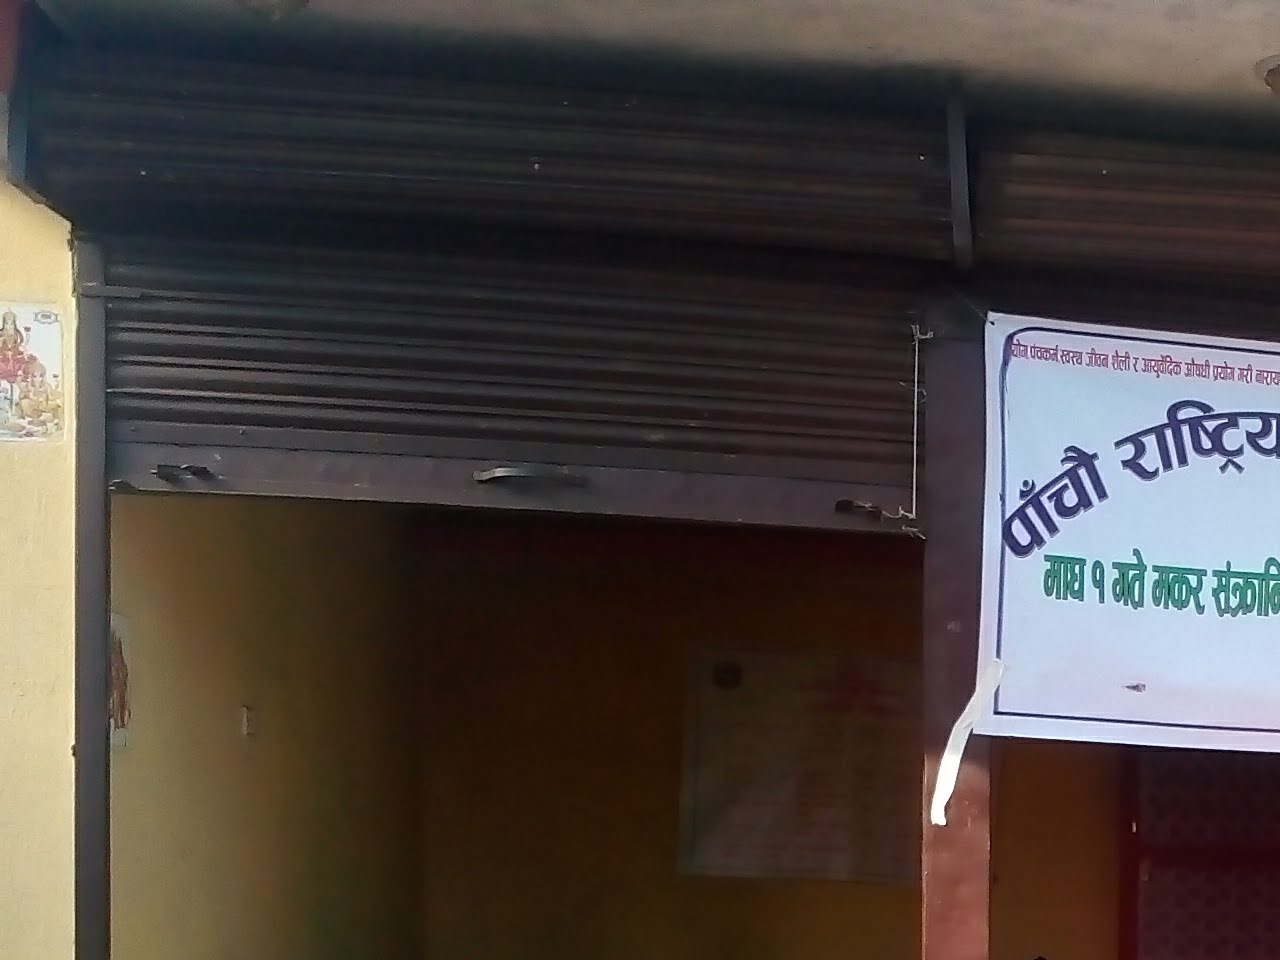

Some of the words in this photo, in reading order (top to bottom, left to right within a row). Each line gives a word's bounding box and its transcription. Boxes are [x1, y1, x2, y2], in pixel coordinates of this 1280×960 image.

[1086, 347, 1109, 369] जीवन
[1133, 357, 1141, 373] र
[1043, 554, 1087, 602] माघ
[1111, 548, 1147, 610] गते
[1151, 565, 1208, 615] मकर
